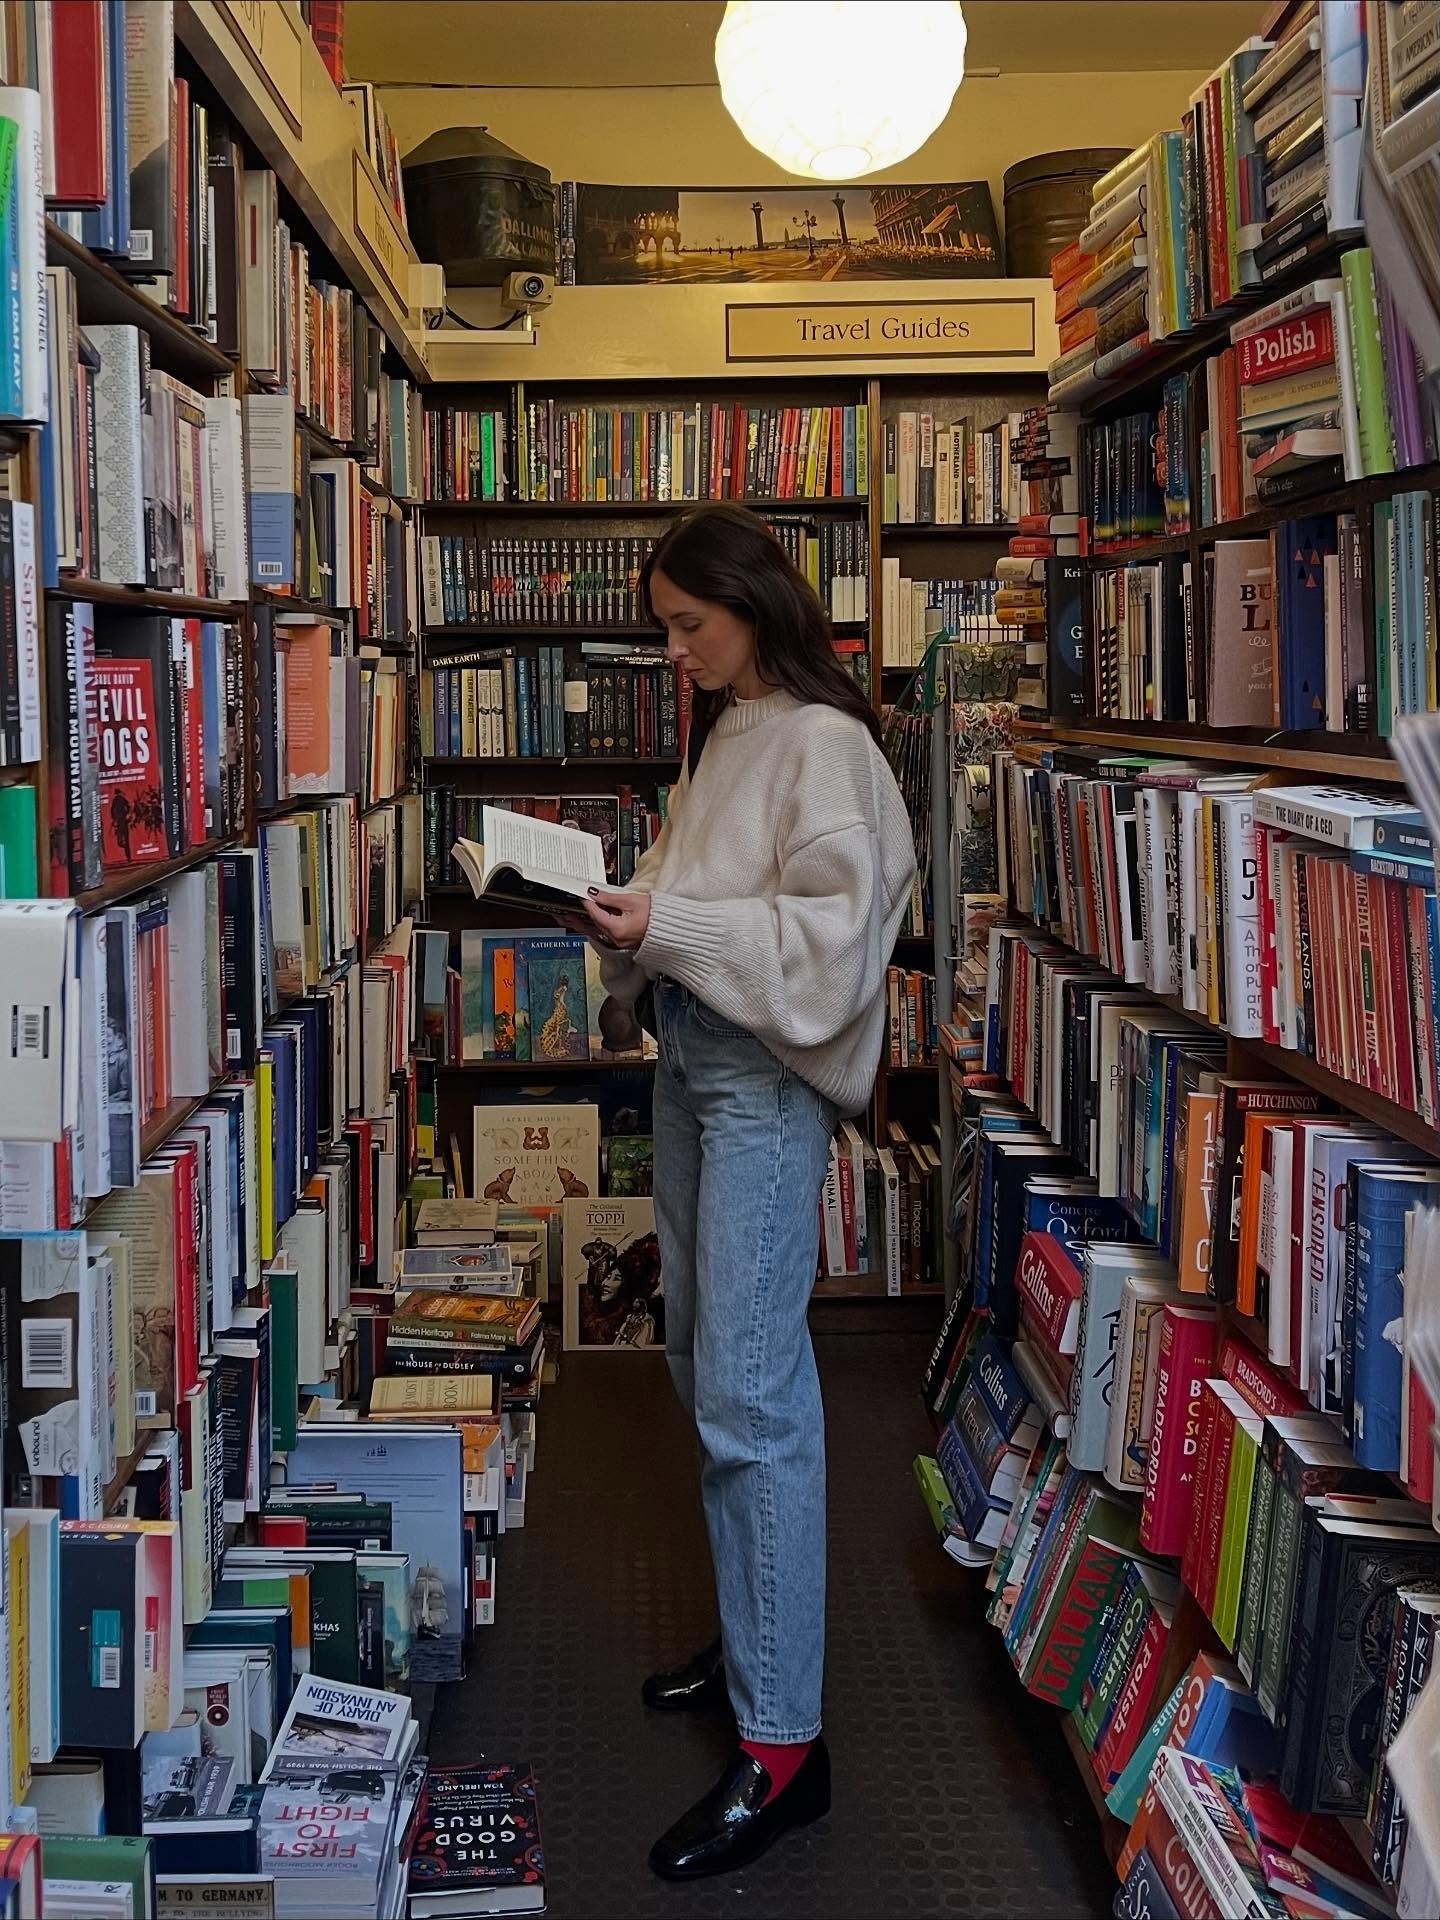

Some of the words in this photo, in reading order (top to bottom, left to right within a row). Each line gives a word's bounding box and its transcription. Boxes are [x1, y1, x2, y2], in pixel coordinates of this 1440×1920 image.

[1405, 25, 1435, 63] AMERICAN
[10, 297, 20, 348] ADAM
[36, 271, 46, 352] DARTNELL
[797, 316, 870, 341] Travel
[880, 316, 970, 340] Guides
[1254, 319, 1317, 368] Polish
[12, 352, 21, 391] KAY
[1243, 340, 1251, 380] Collins
[953, 431, 961, 480] MOTHERLAND
[429, 580, 437, 607] OBLIVION
[21, 563, 38, 681] Sapiens
[1187, 625, 1192, 638] OF
[65, 613, 81, 681] FACING
[432, 657, 454, 667] DARK
[454, 653, 480, 665] EARTH
[113, 674, 135, 685] DAVID
[226, 658, 234, 672] IN
[68, 687, 80, 714] THE
[82, 626, 101, 764] ARNHEM
[99, 687, 148, 723] EVIL
[226, 675, 235, 707] CHIEF
[102, 726, 151, 767] OGS
[69, 718, 82, 820] MOUNTAIN
[1100, 766, 1109, 777] LESS
[1116, 767, 1127, 778] MORE
[563, 808, 586, 819] HARRY
[1275, 805, 1287, 821] THE
[1288, 808, 1305, 826] DIARY
[1305, 814, 1314, 830] OF
[1314, 818, 1320, 832] A
[1320, 819, 1333, 836] CEO
[1144, 823, 1152, 861] MAKING
[1145, 862, 1153, 872] IT
[1370, 858, 1394, 876] BACKSTOP
[1394, 863, 1408, 879] LAND
[1274, 874, 1282, 918] LEADERSHIP
[531, 940, 570, 949] KATHERINE
[1299, 869, 1312, 990] CLEVERLANDS
[1356, 874, 1371, 949] MICHAEL
[1364, 1011, 1378, 1060] LEWIS
[1427, 946, 1437, 1005] Varoufakis
[1432, 1012, 1440, 1061] Another
[1165, 1079, 1173, 1113] Hundred
[1247, 1093, 1320, 1111] HUTCHINSON
[494, 1154, 580, 1166] SOMETHING
[515, 1170, 559, 1183] ABOUT
[825, 1166, 837, 1212] ANIMAL
[586, 1212, 626, 1225] TOPPI
[1049, 1200, 1101, 1216] Concise
[1268, 1190, 1279, 1221] Style
[911, 1200, 922, 1248] MOROCCO
[1046, 1216, 1128, 1237] Oxford
[1311, 1167, 1327, 1282] CENSORED
[1267, 1222, 1279, 1265] Guide
[1345, 1219, 1357, 1288] WRITING
[1021, 1249, 1054, 1320] Collins
[1346, 1293, 1356, 1318] IN
[391, 1325, 420, 1337] Hidden
[421, 1327, 454, 1339] Heritage
[470, 1331, 490, 1340] Fatima
[923, 1284, 963, 1384] SCRABBLE
[405, 1360, 433, 1369] HOUSE
[443, 1362, 475, 1370] DUDLEY
[443, 1382, 458, 1409] BOOK
[979, 1353, 1008, 1411] Collins
[1236, 1360, 1279, 1412] BRADFORD'S
[962, 1397, 990, 1455] French
[1144, 1367, 1170, 1503] BRADFORD'S
[32, 1420, 41, 1467] unbound
[1248, 1549, 1266, 1642] DICTIONARY
[313, 1623, 340, 1633] KHAS
[1036, 1546, 1118, 1699] ITALIAN
[1269, 1580, 1288, 1676] DICTIONARY
[1099, 1597, 1144, 1701] Collins
[306, 1685, 372, 1711] INVASION
[1113, 1641, 1153, 1734] Polish
[313, 1701, 334, 1716] OF
[335, 1706, 382, 1723] DIARY
[373, 1698, 397, 1713] AN
[1152, 1675, 1190, 1737] Collins
[285, 1762, 306, 1770] 1939
[308, 1762, 329, 1770] WAR
[330, 1762, 361, 1770] POLISH
[436, 1783, 481, 1792] IRELAND
[483, 1782, 504, 1790] TOM
[274, 1805, 371, 1822] FIGHT
[433, 1813, 516, 1829] VIRUS
[296, 1825, 339, 1840] TO
[435, 1830, 516, 1846] GOOD
[268, 1842, 358, 1858] FIRST
[456, 1848, 499, 1861] THE
[176, 1888, 193, 1902] TO
[201, 1887, 267, 1902] GERMANY.
